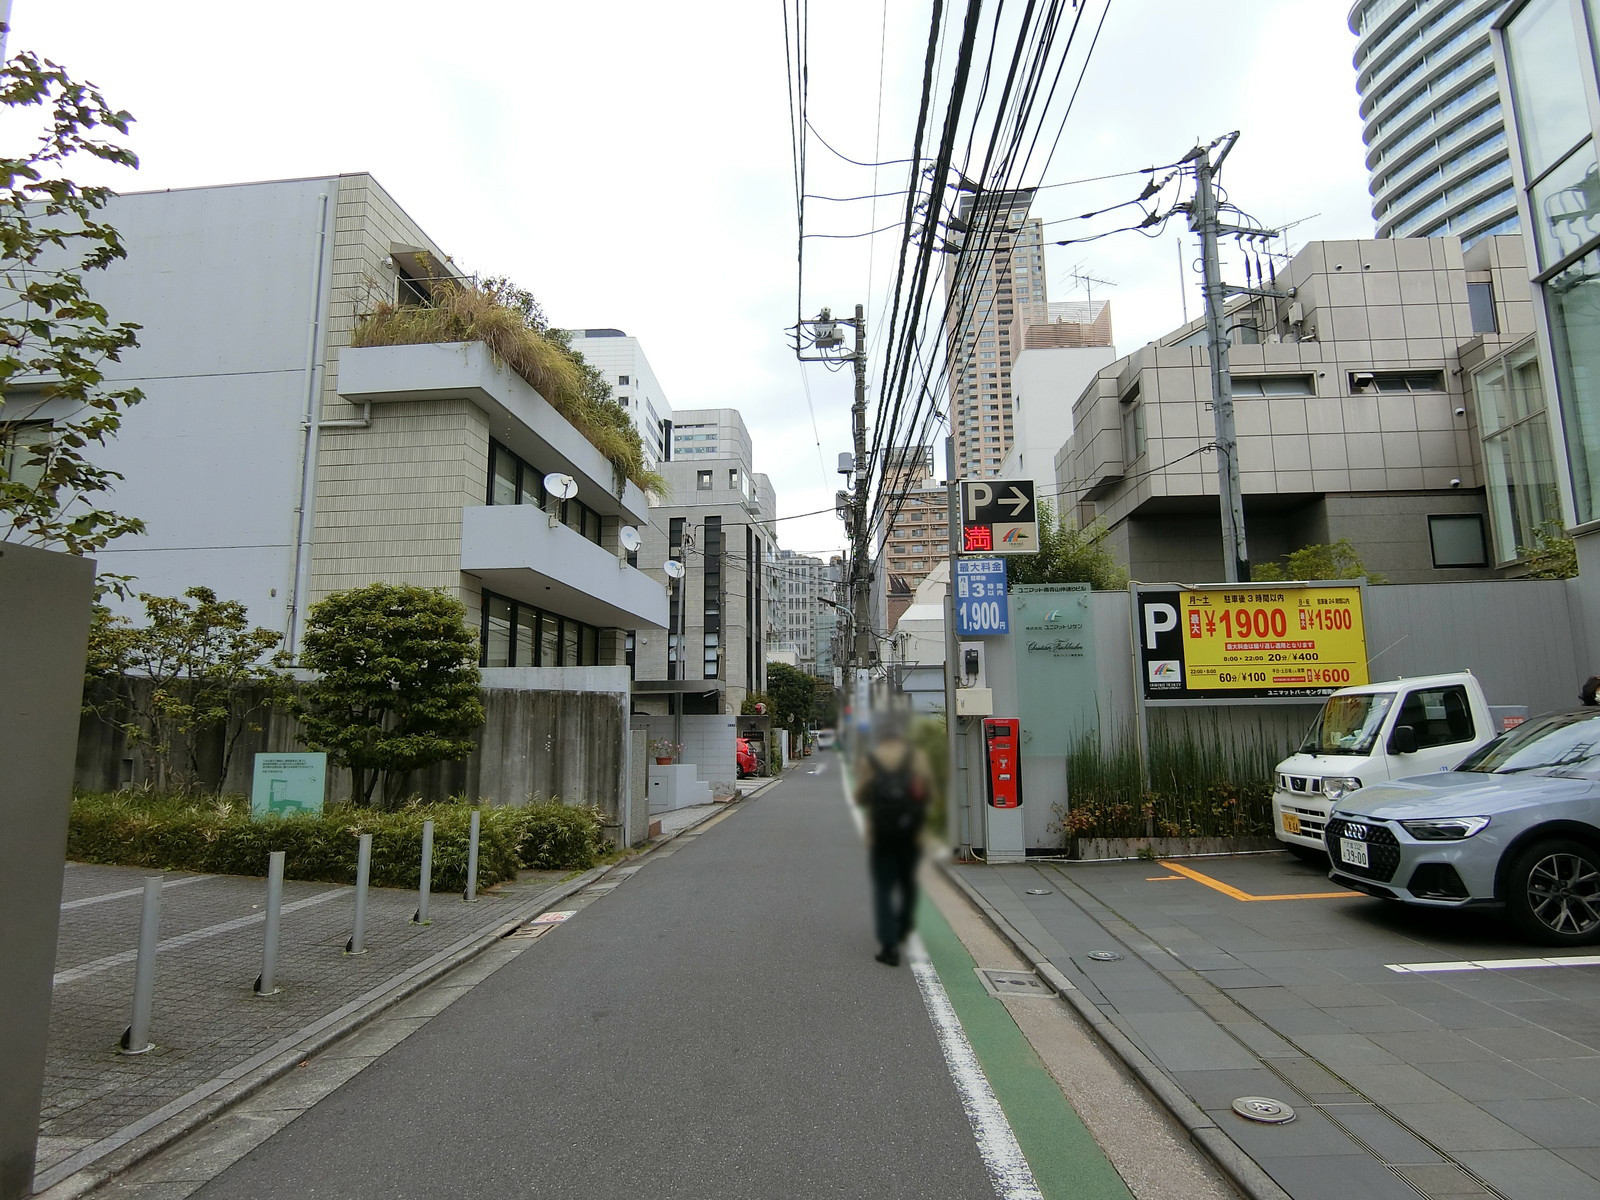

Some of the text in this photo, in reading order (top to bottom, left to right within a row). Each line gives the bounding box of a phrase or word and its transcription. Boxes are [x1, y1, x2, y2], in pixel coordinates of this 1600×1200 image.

[968, 483, 992, 520] P
[964, 526, 991, 551] 満
[959, 562, 1002, 572] 最大料金
[972, 583, 985, 597] 3
[1144, 603, 1177, 649] P
[1190, 614, 1200, 633] 最大
[1204, 608, 1287, 638] ¥1900
[1307, 608, 1352, 630] ¥1500
[1314, 669, 1350, 682] ¥600
[1346, 849, 1367, 865] 39-00
